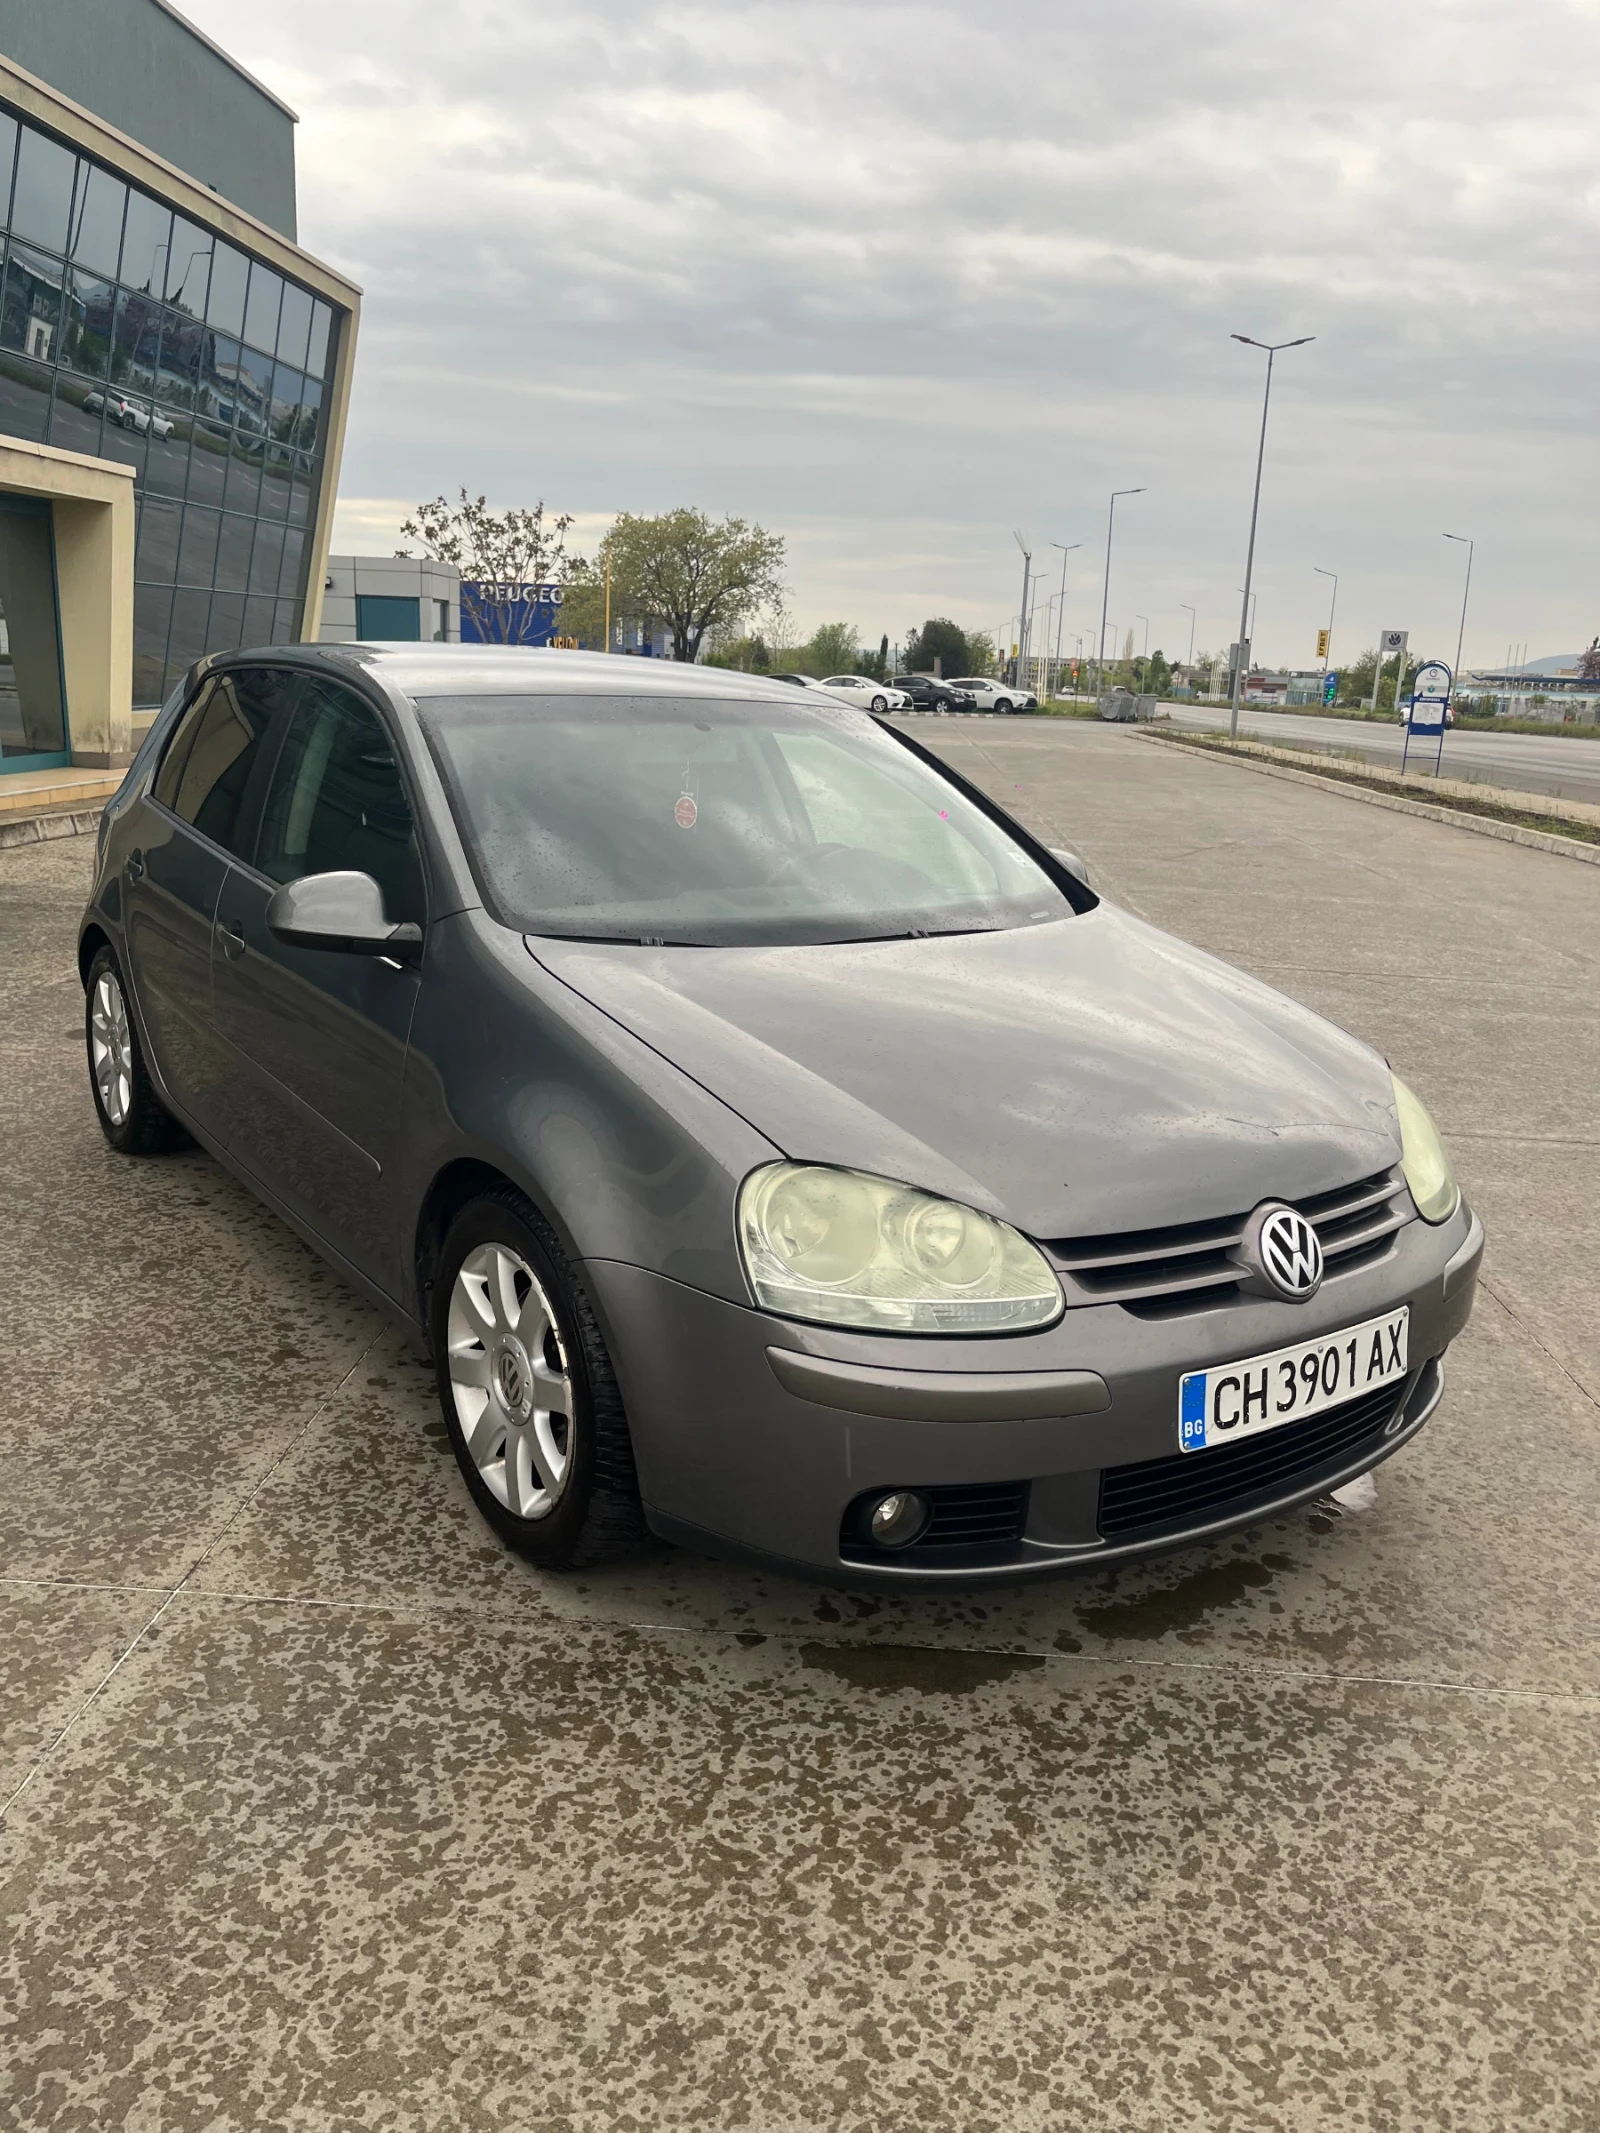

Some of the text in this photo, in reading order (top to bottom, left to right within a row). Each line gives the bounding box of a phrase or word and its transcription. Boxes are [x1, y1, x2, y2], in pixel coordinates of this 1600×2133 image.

[480, 584, 565, 604] PEUGEO
[1213, 1319, 1403, 1430] CH 3901 AX
[1184, 1419, 1203, 1438] BG
